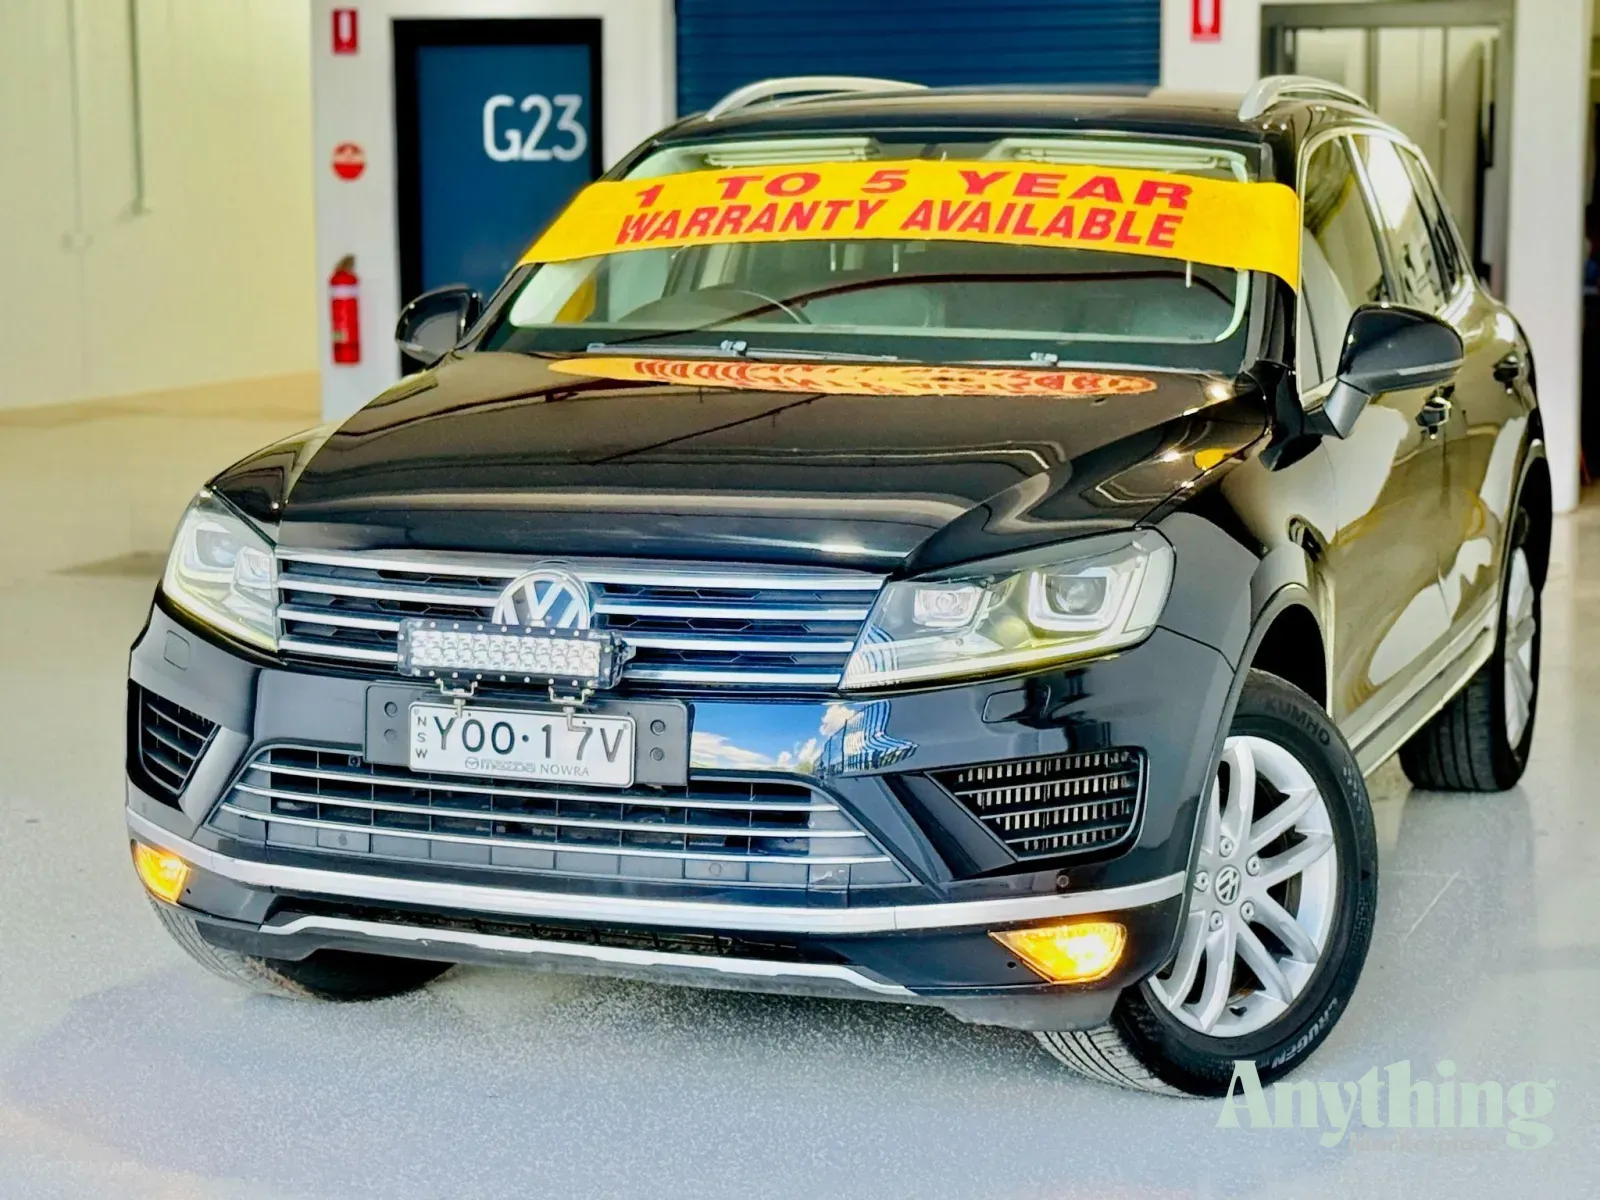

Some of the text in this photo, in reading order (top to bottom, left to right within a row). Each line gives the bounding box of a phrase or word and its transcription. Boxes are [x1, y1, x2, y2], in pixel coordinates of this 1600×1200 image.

[483, 94, 587, 162] G23
[635, 169, 1193, 210] 1 TO 5 YEAR
[615, 199, 1184, 249] WARRANTY AVAILABLE
[1264, 695, 1331, 746] KUMHO
[540, 763, 590, 777] NOWRA
